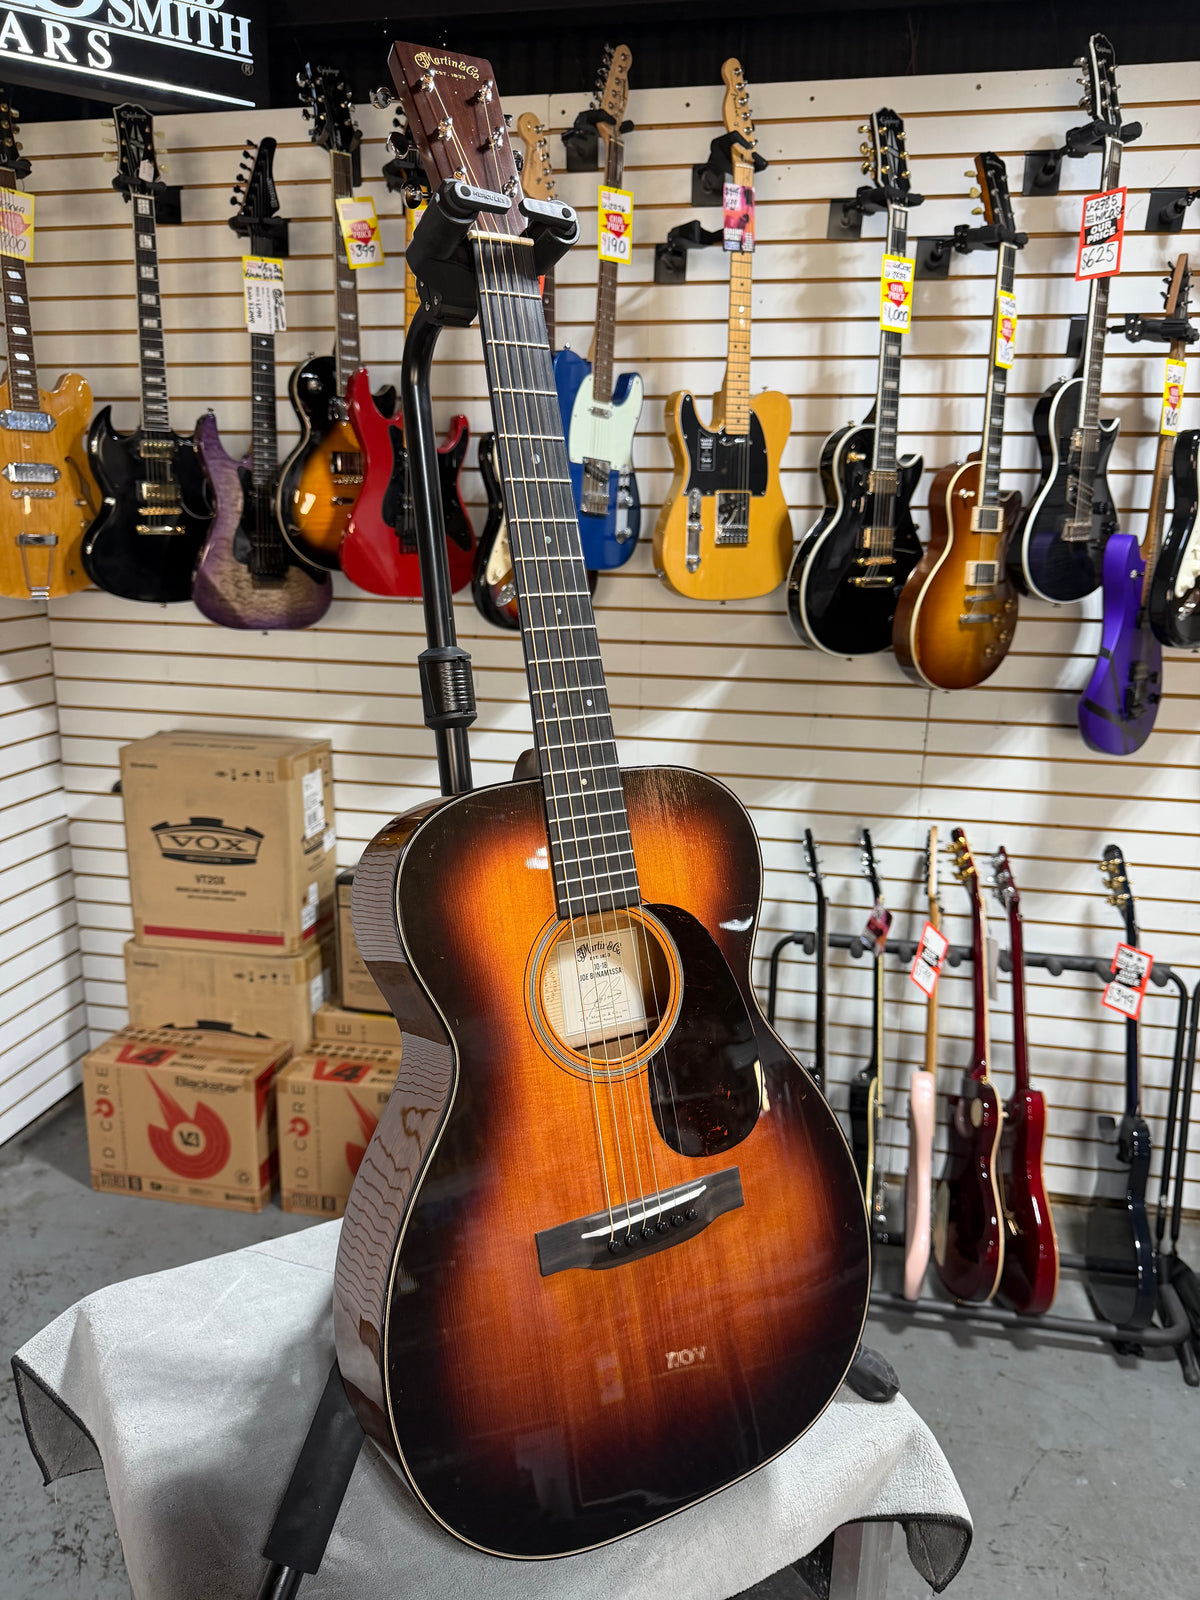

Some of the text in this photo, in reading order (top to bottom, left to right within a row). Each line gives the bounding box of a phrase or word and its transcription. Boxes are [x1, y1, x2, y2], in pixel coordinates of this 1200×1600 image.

[1086, 226, 1117, 245] PRICE
[1090, 220, 1112, 235] OUR
[1082, 243, 1115, 270] $625
[165, 834, 250, 853] VOX
[589, 967, 622, 980] BNAMASSA
